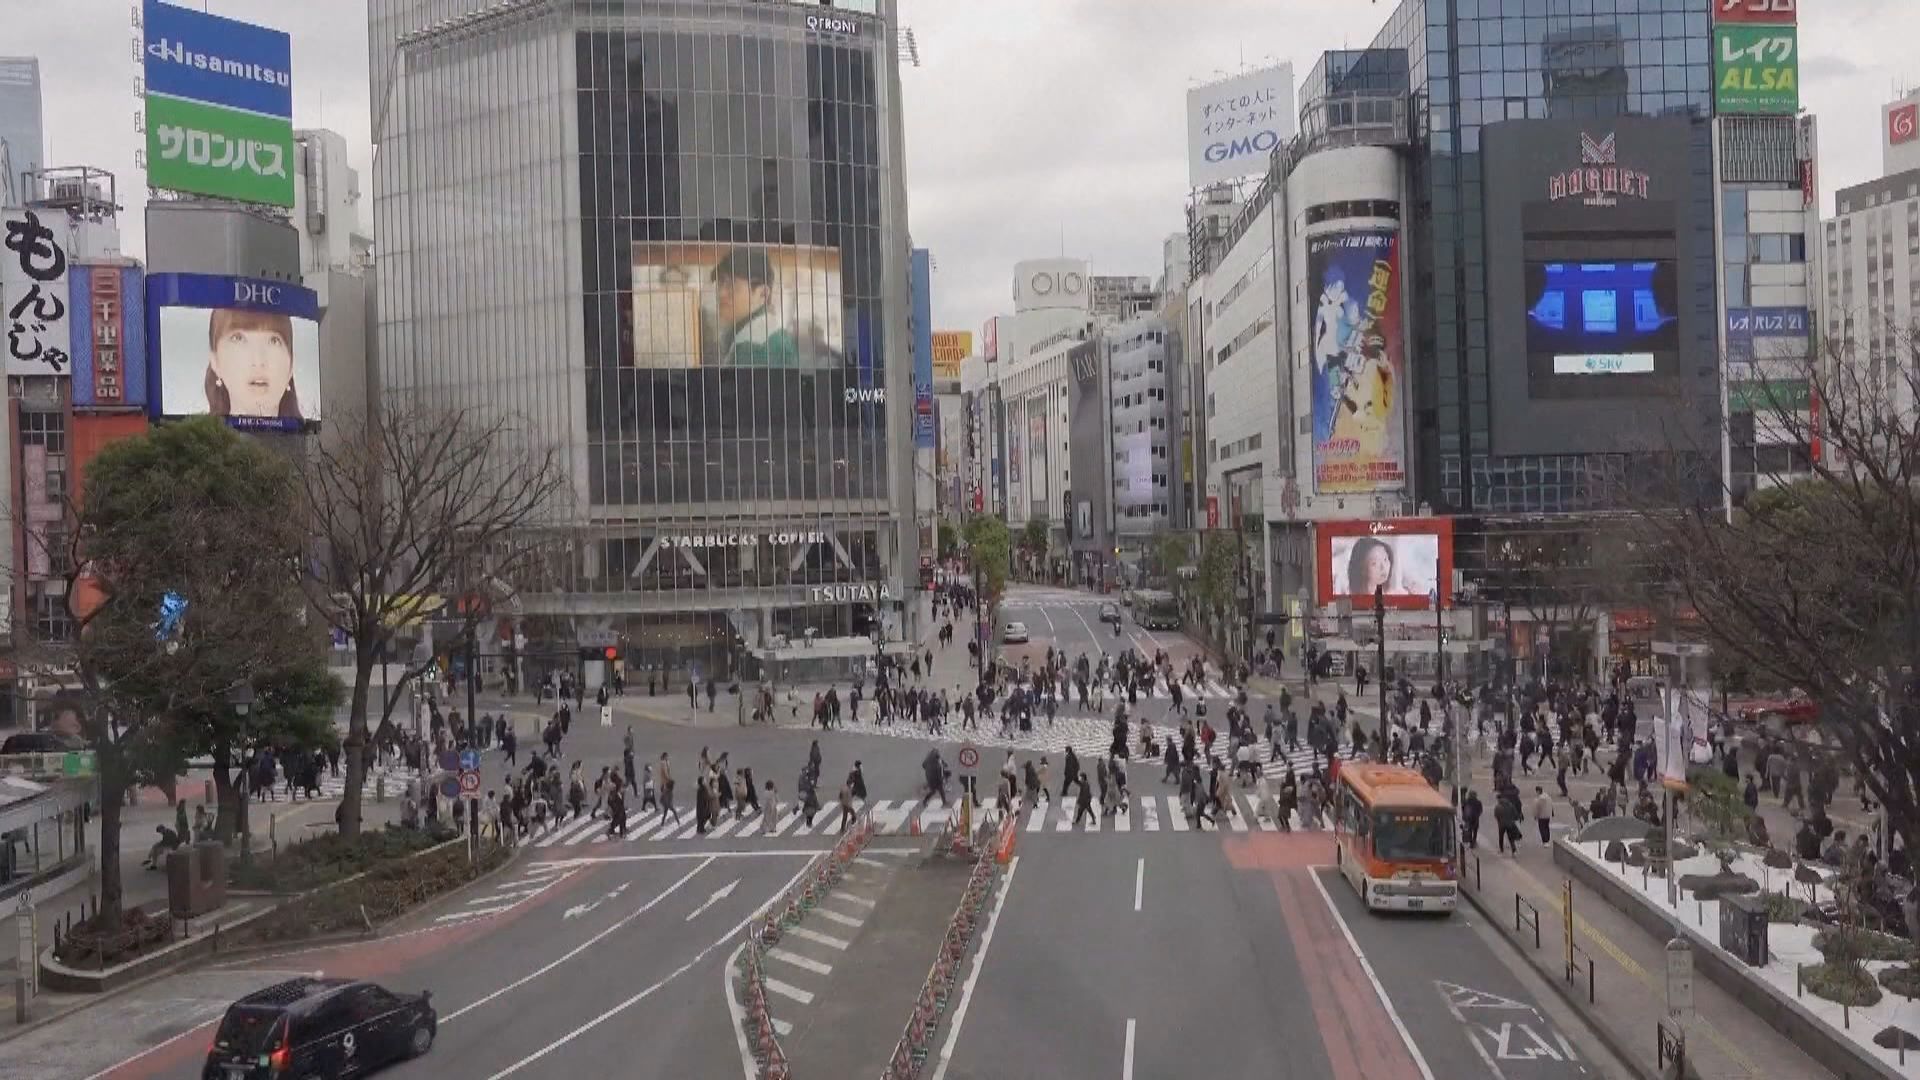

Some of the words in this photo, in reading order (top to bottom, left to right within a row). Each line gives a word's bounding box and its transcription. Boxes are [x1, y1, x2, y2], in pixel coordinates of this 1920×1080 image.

[148, 38, 289, 87] Hisamitsu
[1722, 36, 1793, 63] レイク
[1720, 67, 1793, 91] ALSA
[1203, 88, 1277, 118] すべての人に
[1204, 105, 1277, 136] インターネット
[157, 124, 286, 179] サロンパス
[1205, 130, 1277, 162] GMO
[1550, 168, 1649, 201] MAGNET
[5, 210, 69, 372] もんじゃ
[234, 282, 281, 305] DHC
[660, 533, 758, 548] STARBUCKS
[768, 532, 825, 545] COFFEE
[811, 584, 890, 602] TSUTAYA
